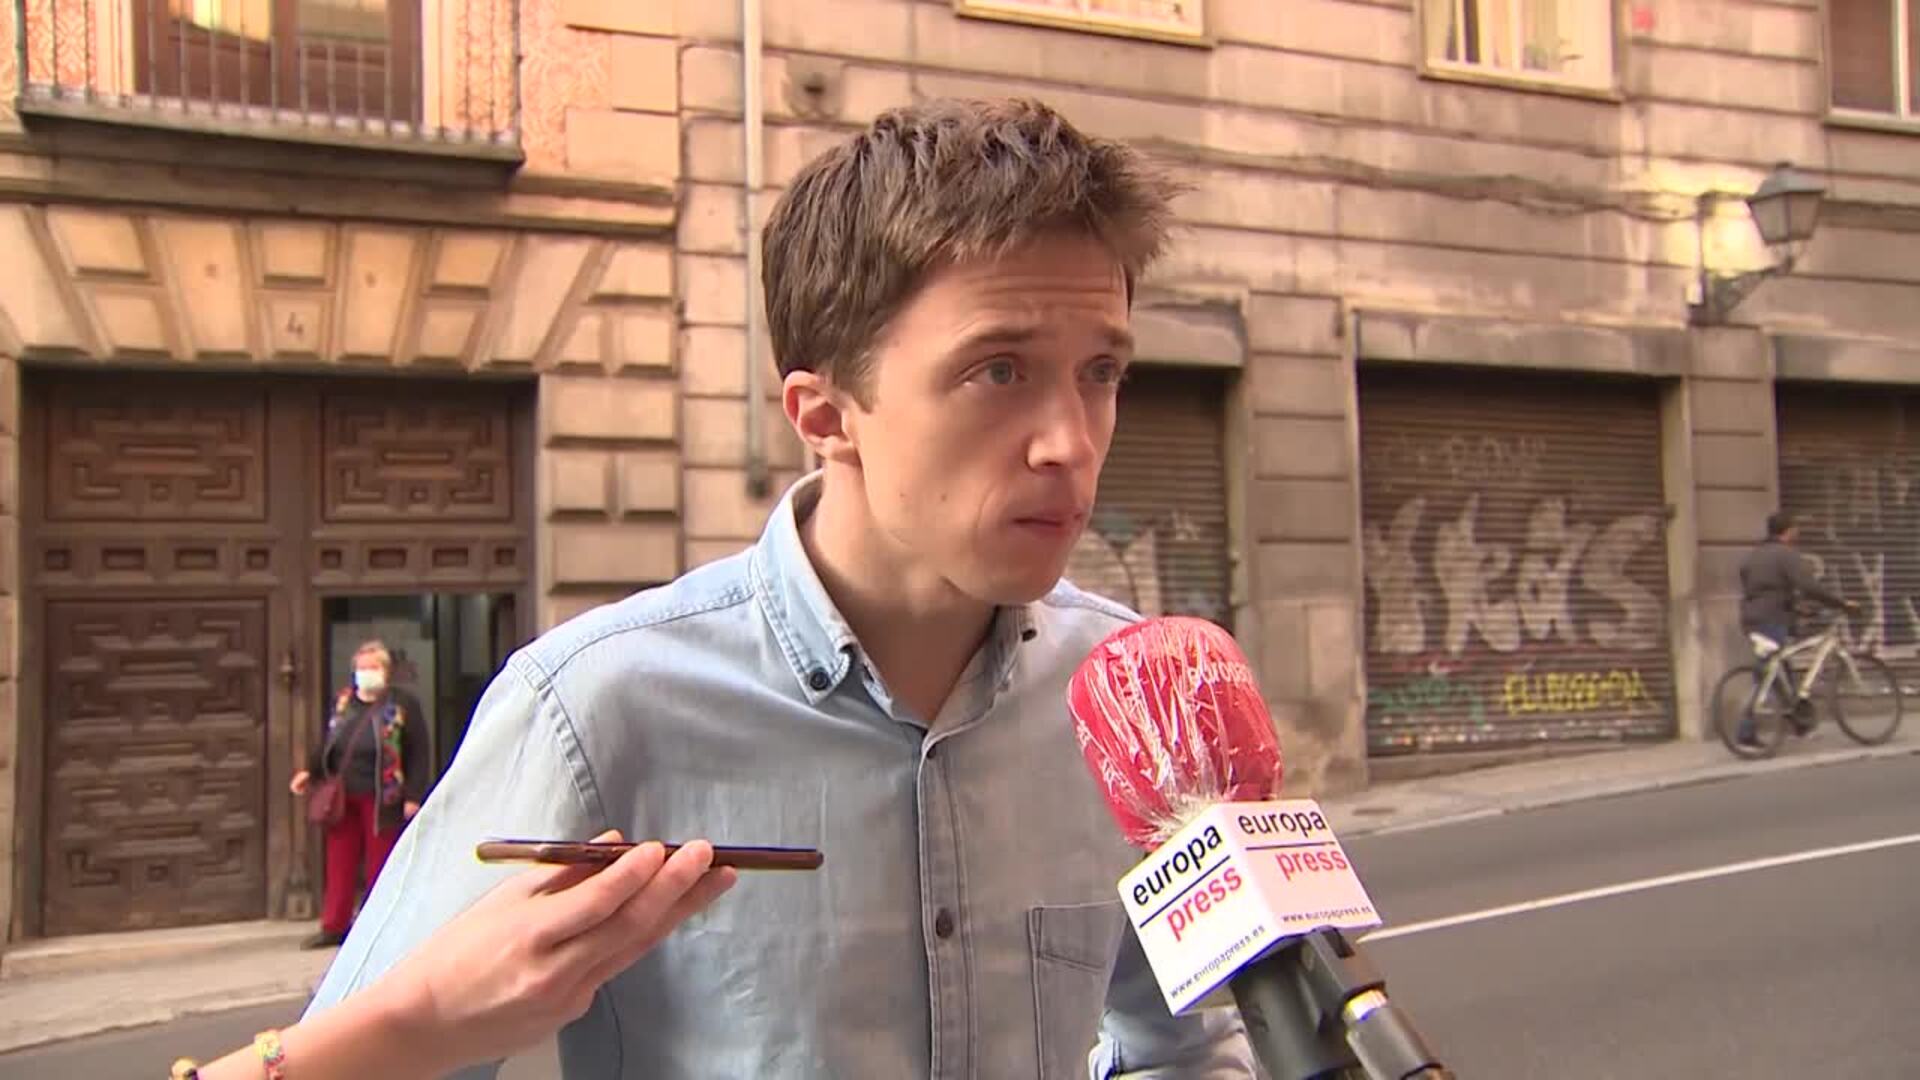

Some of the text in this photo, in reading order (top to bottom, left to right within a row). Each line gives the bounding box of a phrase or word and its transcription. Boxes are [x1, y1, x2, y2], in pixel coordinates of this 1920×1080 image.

[1238, 809, 1328, 838] europa
[1132, 824, 1223, 906] europa
[1275, 849, 1349, 881] press
[1166, 866, 1243, 942] press
[1281, 905, 1373, 922] www.europapress.es
[1169, 924, 1266, 999] www.europapress.es
